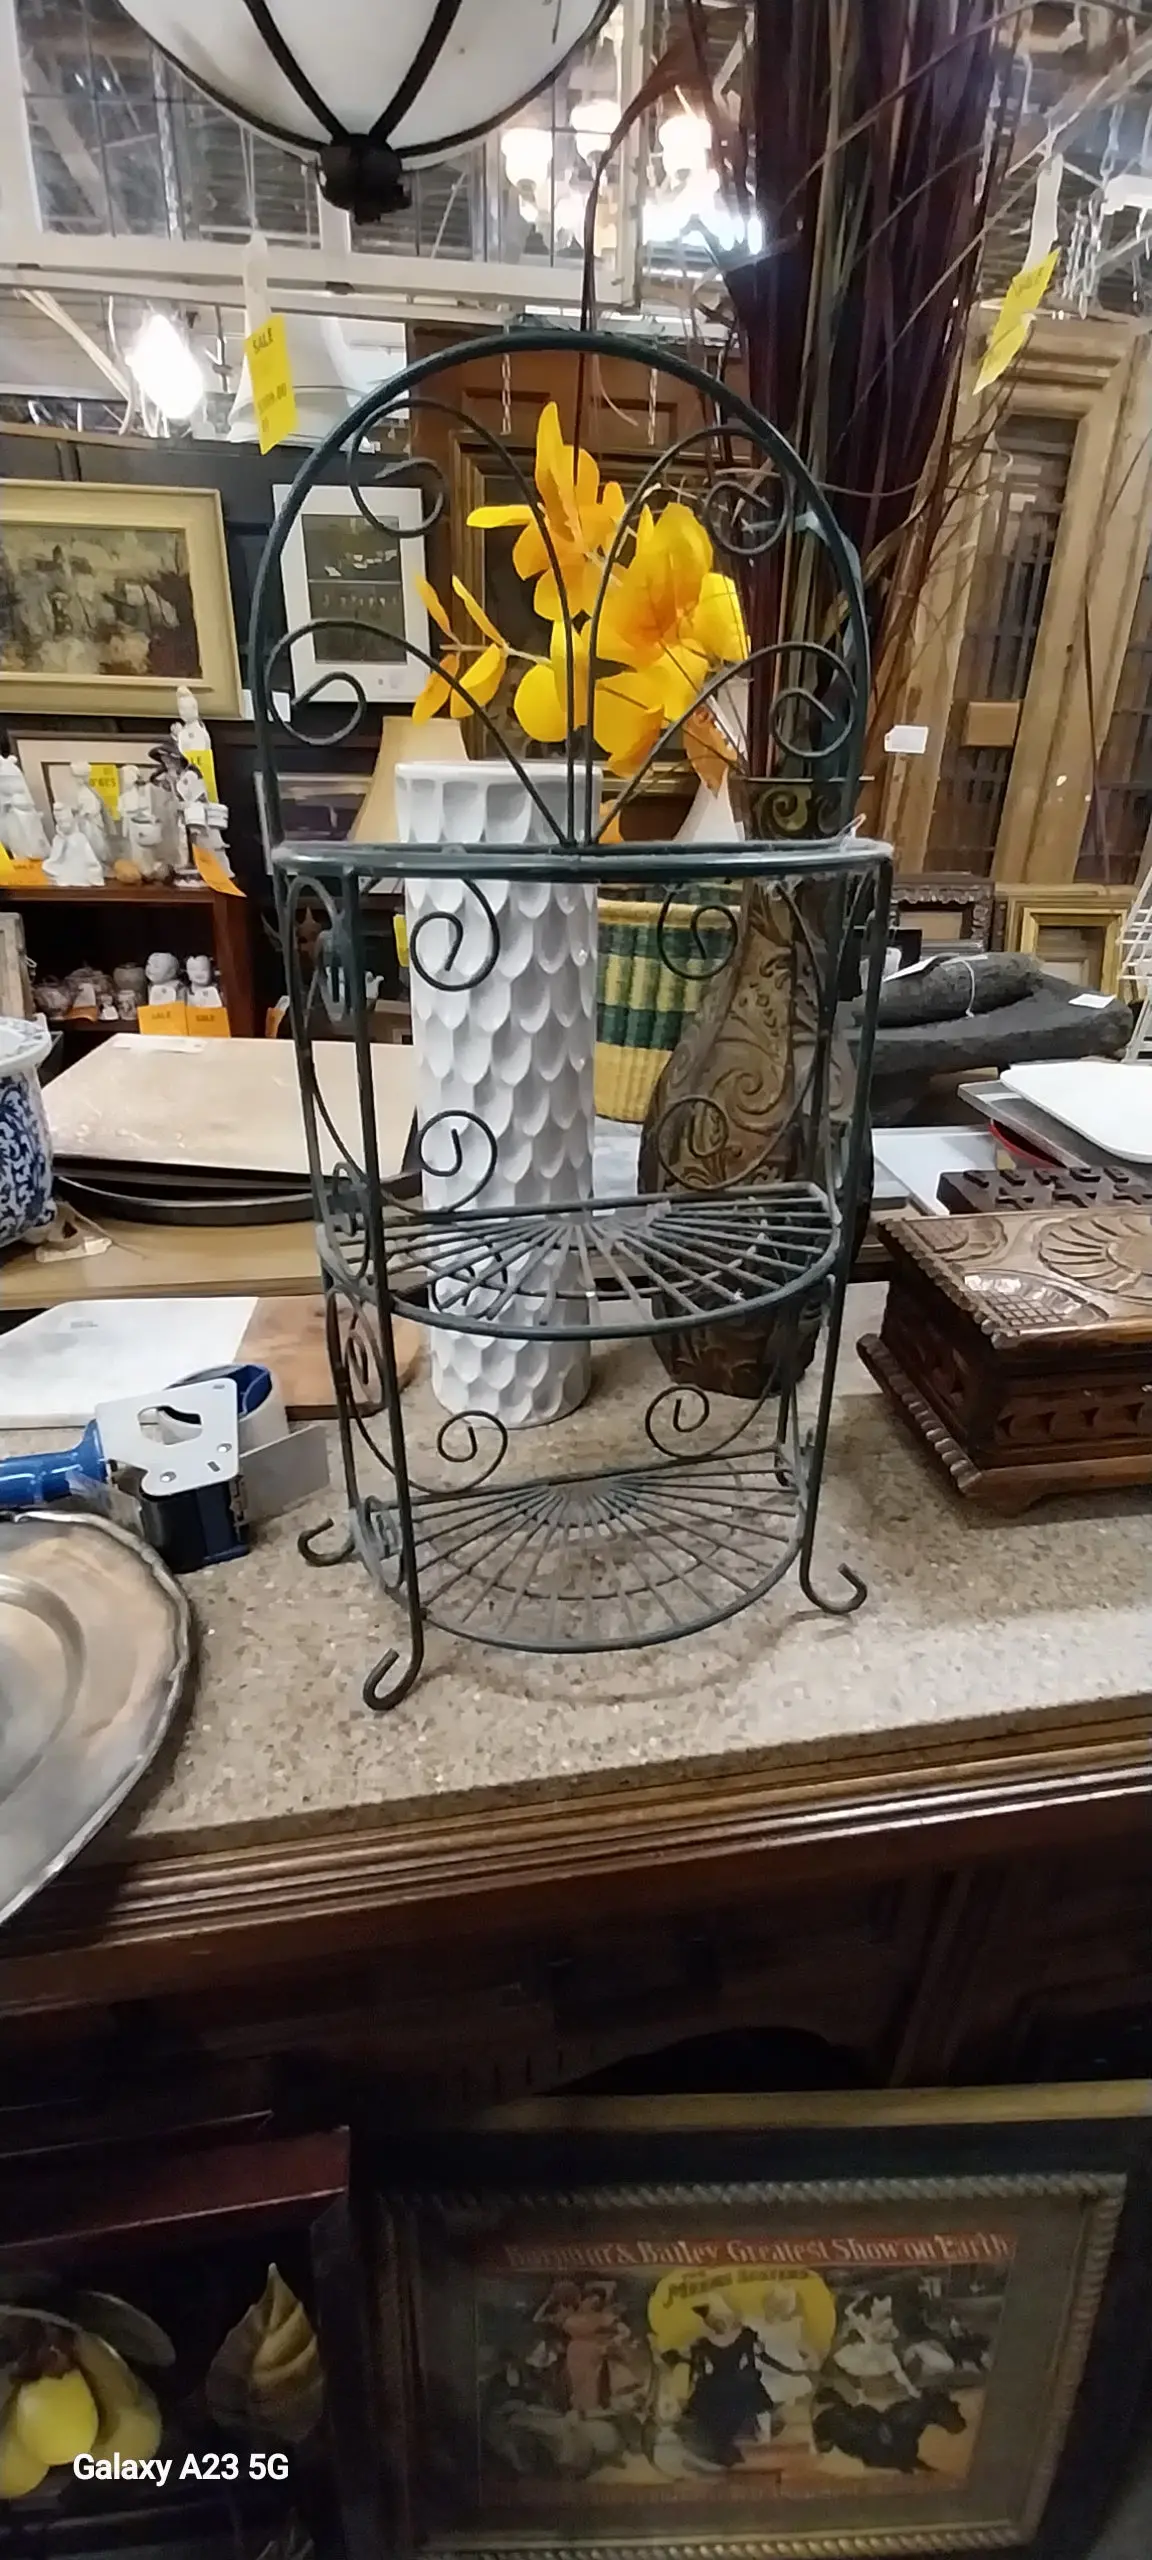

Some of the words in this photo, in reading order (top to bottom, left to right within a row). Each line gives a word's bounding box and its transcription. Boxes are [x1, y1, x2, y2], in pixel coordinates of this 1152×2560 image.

[252, 327, 274, 355] SALE
[637, 2240, 718, 2265] Bailey
[727, 2237, 830, 2262] Greatest
[832, 2236, 898, 2261] Show
[934, 2231, 1009, 2260] Earth
